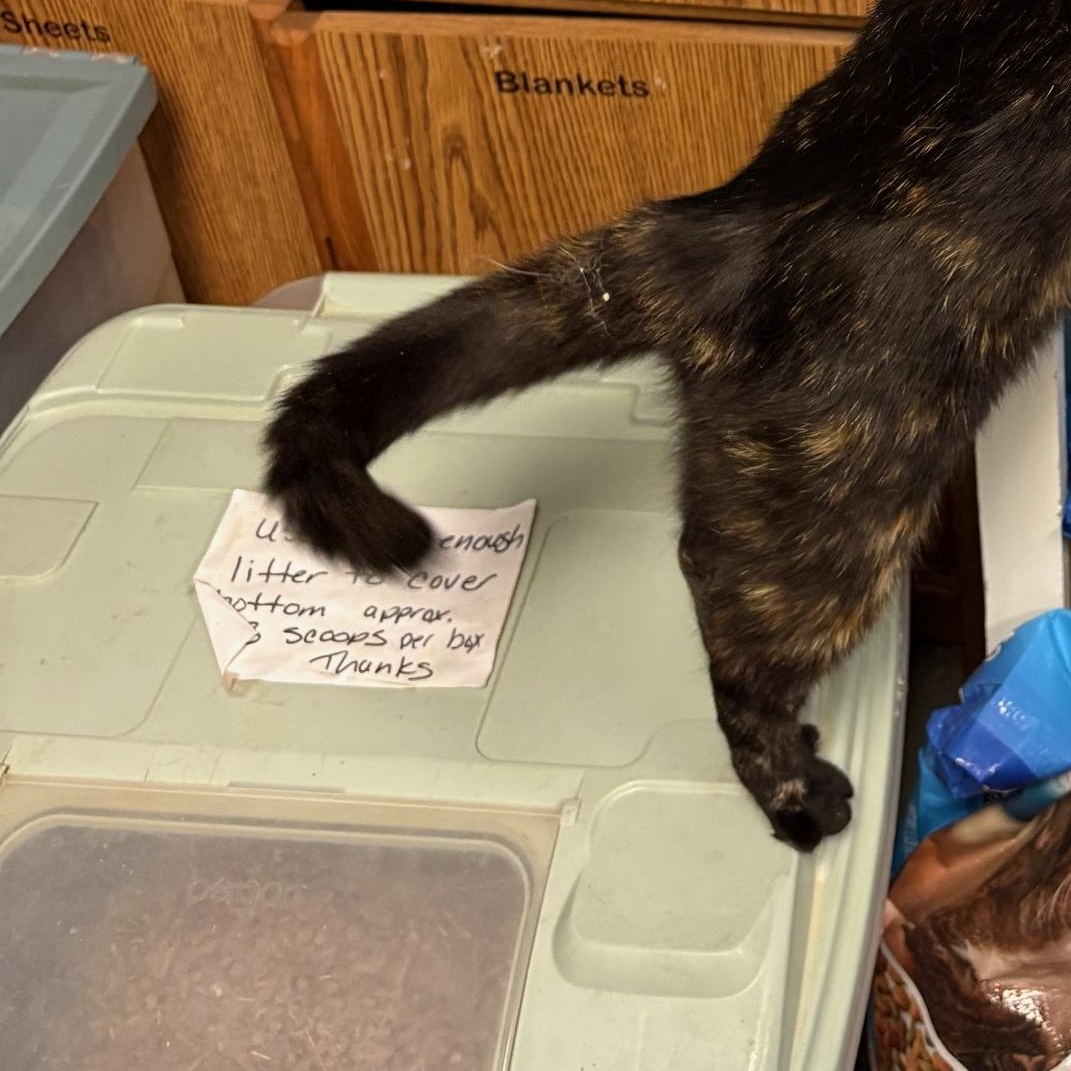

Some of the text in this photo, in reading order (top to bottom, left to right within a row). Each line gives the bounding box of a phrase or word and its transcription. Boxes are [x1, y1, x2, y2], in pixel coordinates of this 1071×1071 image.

[0, 11, 111, 43] Sheets
[494, 70, 650, 98] Blankets
[439, 523, 525, 554] enough
[230, 555, 329, 585] litter
[407, 571, 498, 592] cover
[283, 626, 486, 652] scoops per box
[310, 650, 434, 681] Thanks
